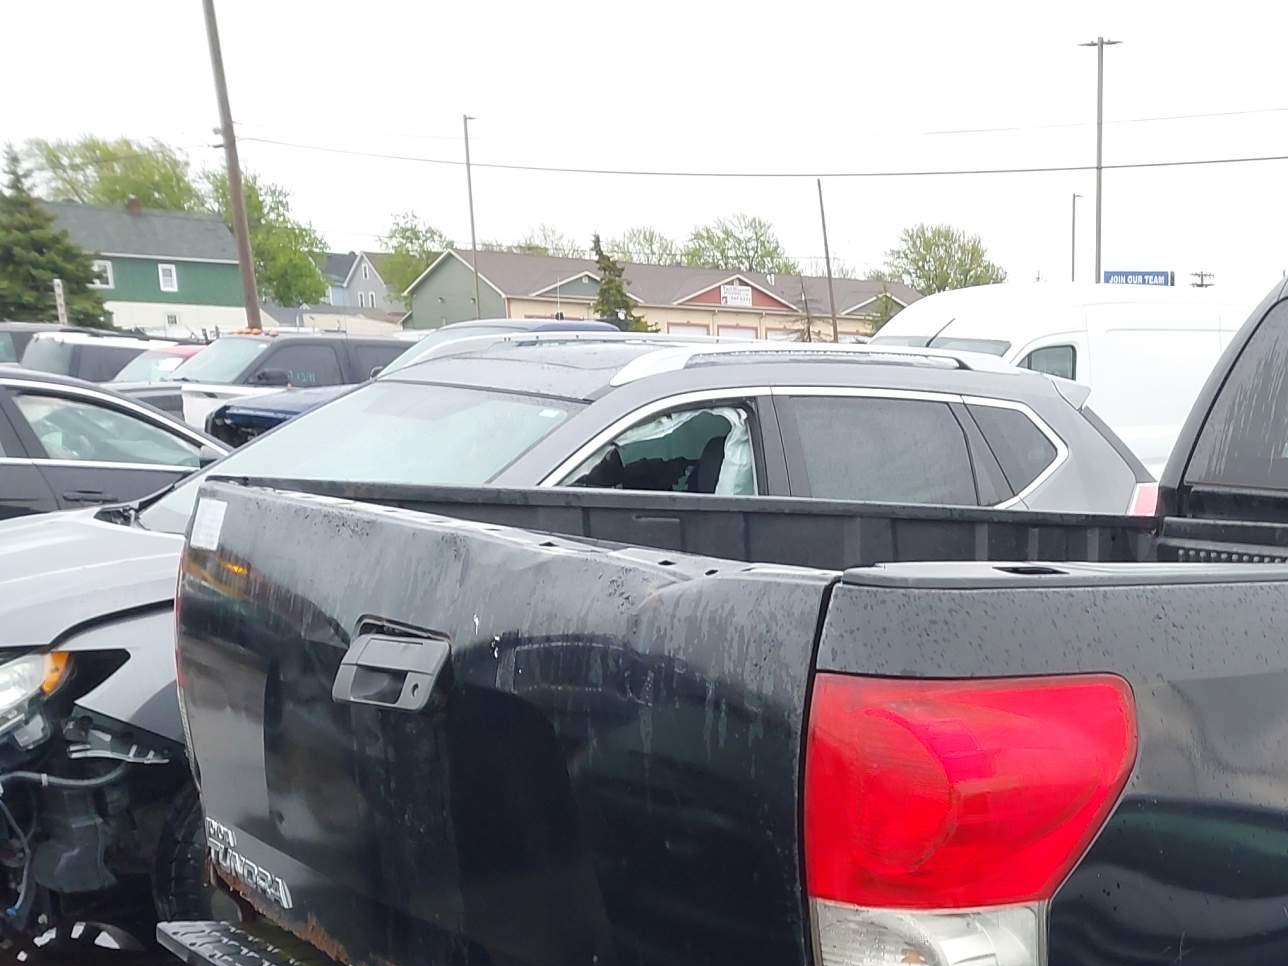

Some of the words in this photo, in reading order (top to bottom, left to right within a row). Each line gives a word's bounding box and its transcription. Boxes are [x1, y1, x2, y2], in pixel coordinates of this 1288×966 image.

[1109, 274, 1127, 285] JOIN
[1127, 274, 1143, 284] OUR
[1144, 275, 1165, 286] TEAM
[207, 837, 294, 910] TUNDRA
